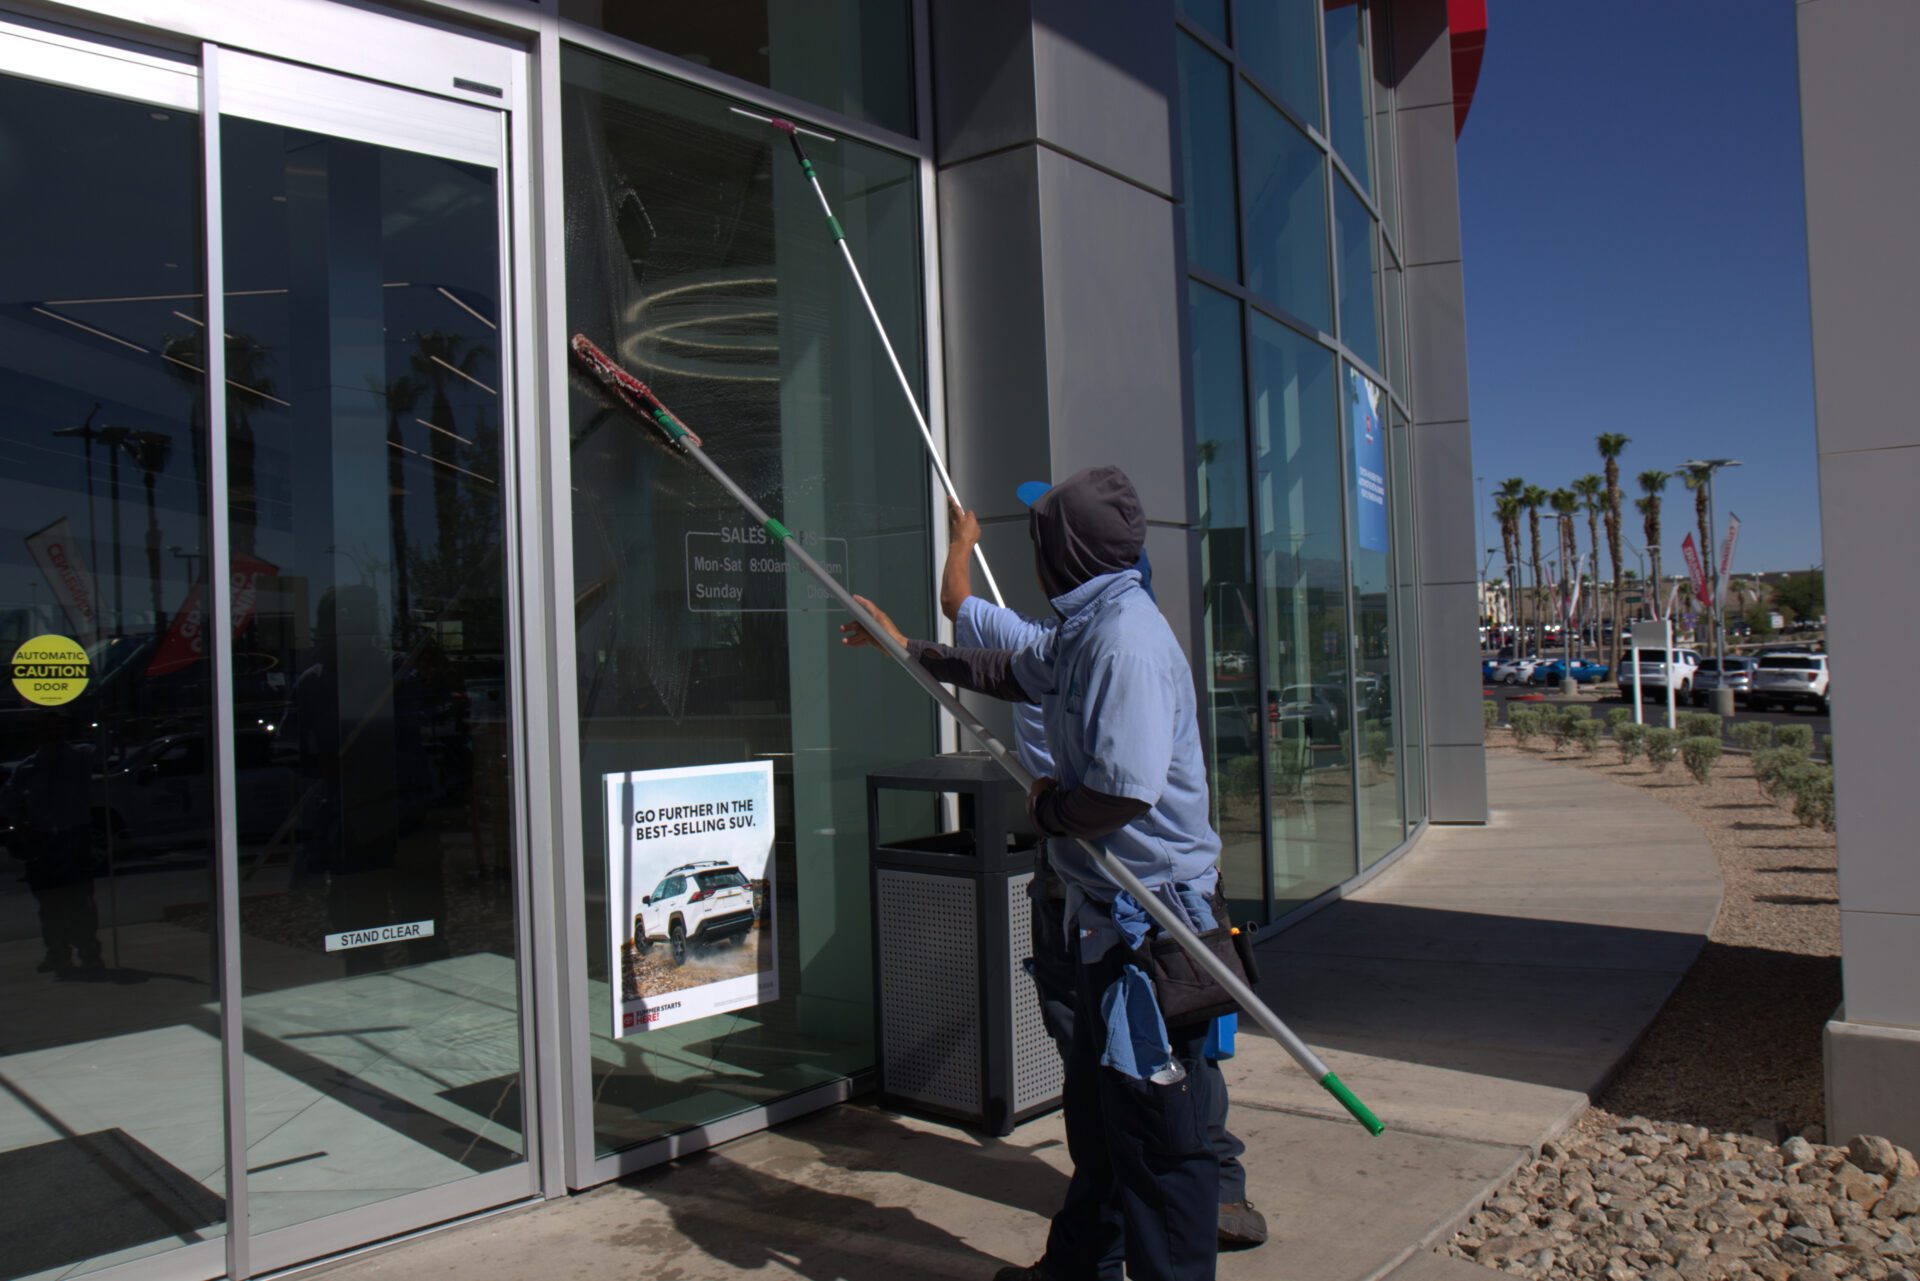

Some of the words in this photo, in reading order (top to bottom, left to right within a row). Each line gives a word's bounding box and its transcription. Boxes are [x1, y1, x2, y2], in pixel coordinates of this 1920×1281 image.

[720, 526, 767, 545] SALES
[694, 555, 743, 572] Mon-Sat
[749, 557, 790, 573] 8:00am
[696, 583, 743, 601] Sunday
[16, 651, 85, 660] AUTOMATIC
[14, 665, 87, 677] CAUTION
[34, 682, 69, 691] DOOR
[634, 809, 656, 824] GO
[658, 803, 714, 821] FURTHER
[716, 801, 729, 815] IN
[731, 799, 753, 813] THE
[636, 818, 726, 841] BEST-SELLING
[729, 815, 756, 829] SUV.
[340, 930, 379, 946] STAND
[382, 924, 420, 940] CLEAR
[660, 1001, 682, 1012] STARTS
[636, 1012, 660, 1025] HERE!
